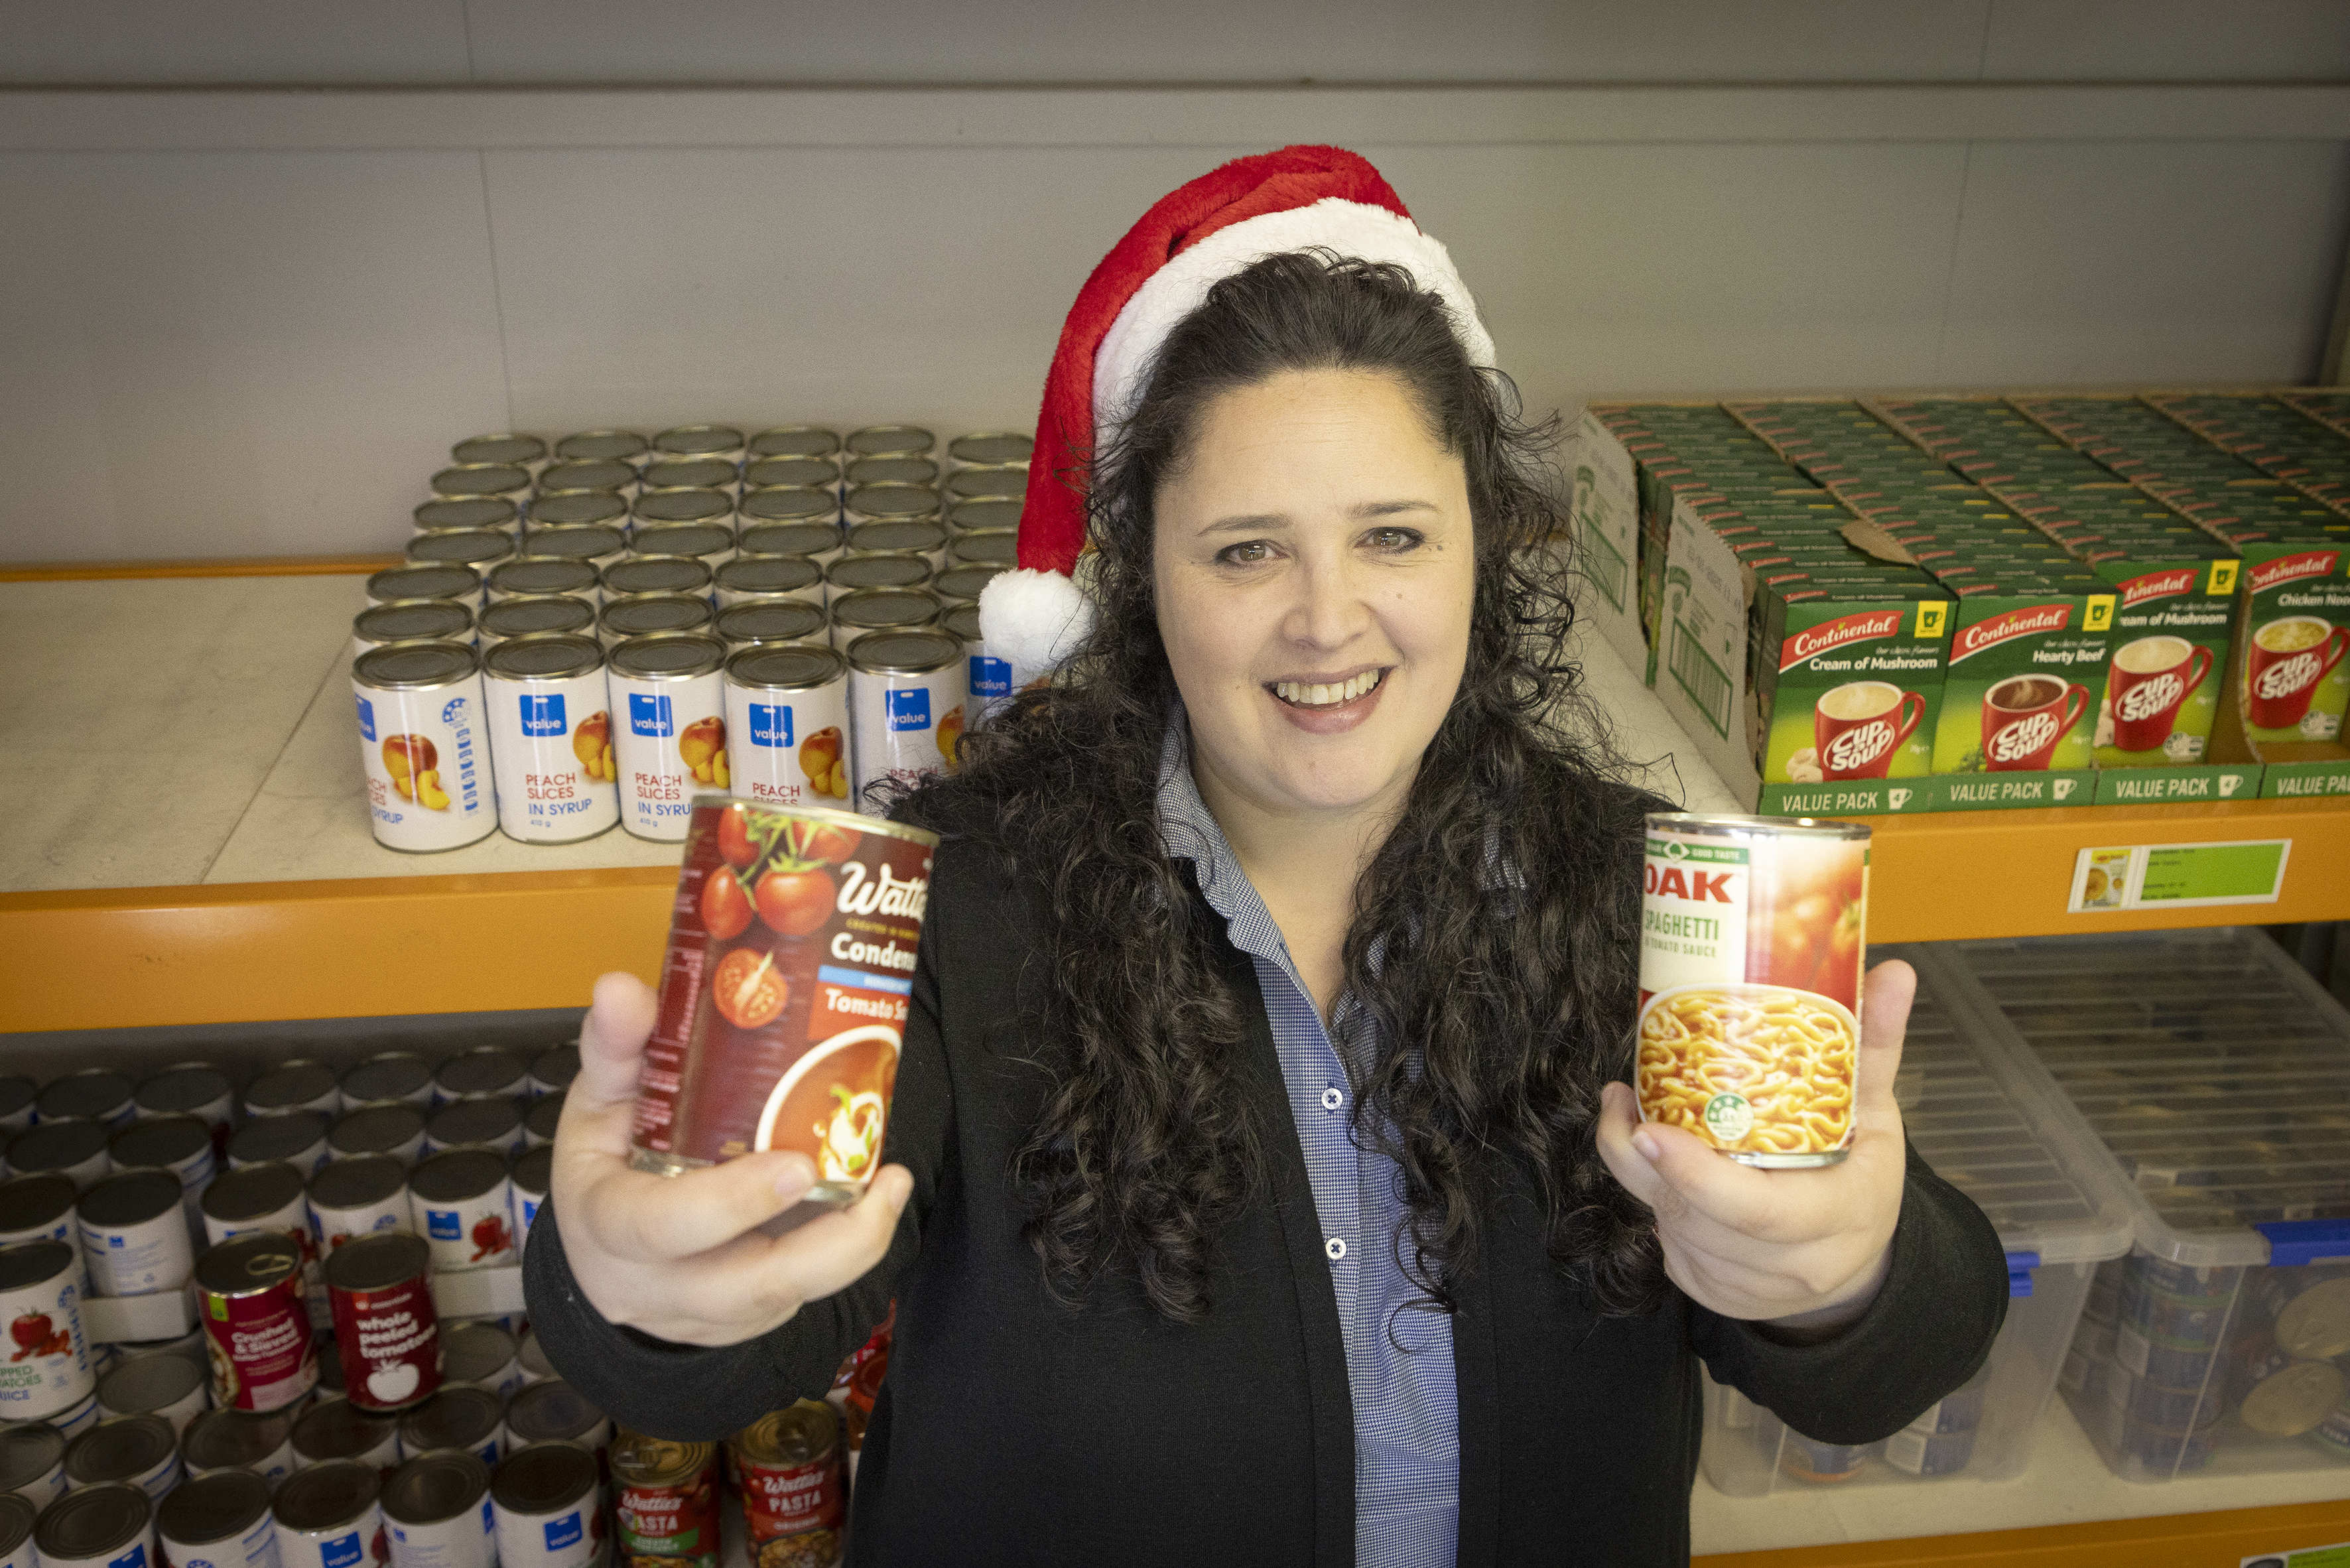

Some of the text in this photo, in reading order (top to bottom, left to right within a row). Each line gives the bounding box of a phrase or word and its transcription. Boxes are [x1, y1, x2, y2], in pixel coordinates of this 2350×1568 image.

[2278, 592, 2324, 606] Chicken
[2149, 612, 2165, 626] of
[2164, 612, 2227, 625] Mushroom
[1794, 616, 1895, 656] Continental
[1965, 610, 2064, 649] Continental
[2033, 648, 2106, 665] Hearty Beef
[1809, 657, 1937, 671] Cream of Mushroom
[974, 679, 1007, 690] value
[526, 718, 562, 730] value
[635, 718, 667, 730] value
[892, 712, 925, 724] value
[754, 729, 788, 740] value
[526, 773, 576, 787] PEACH
[635, 773, 682, 787] PEACH
[2277, 776, 2325, 795] VALUE
[527, 787, 574, 800] SLICES
[637, 787, 681, 801] SLICES
[753, 783, 800, 797] PEACH
[1951, 783, 1999, 801] VALUE
[2001, 781, 2043, 799] PACK
[2117, 779, 2164, 798] VALUE
[2167, 777, 2209, 797] PACK
[529, 799, 592, 816] IN SYRUP
[638, 801, 692, 816] IN SYRU
[1782, 794, 1832, 812] VALUE
[1836, 791, 1878, 810] PACK
[825, 988, 894, 1019] Tomato
